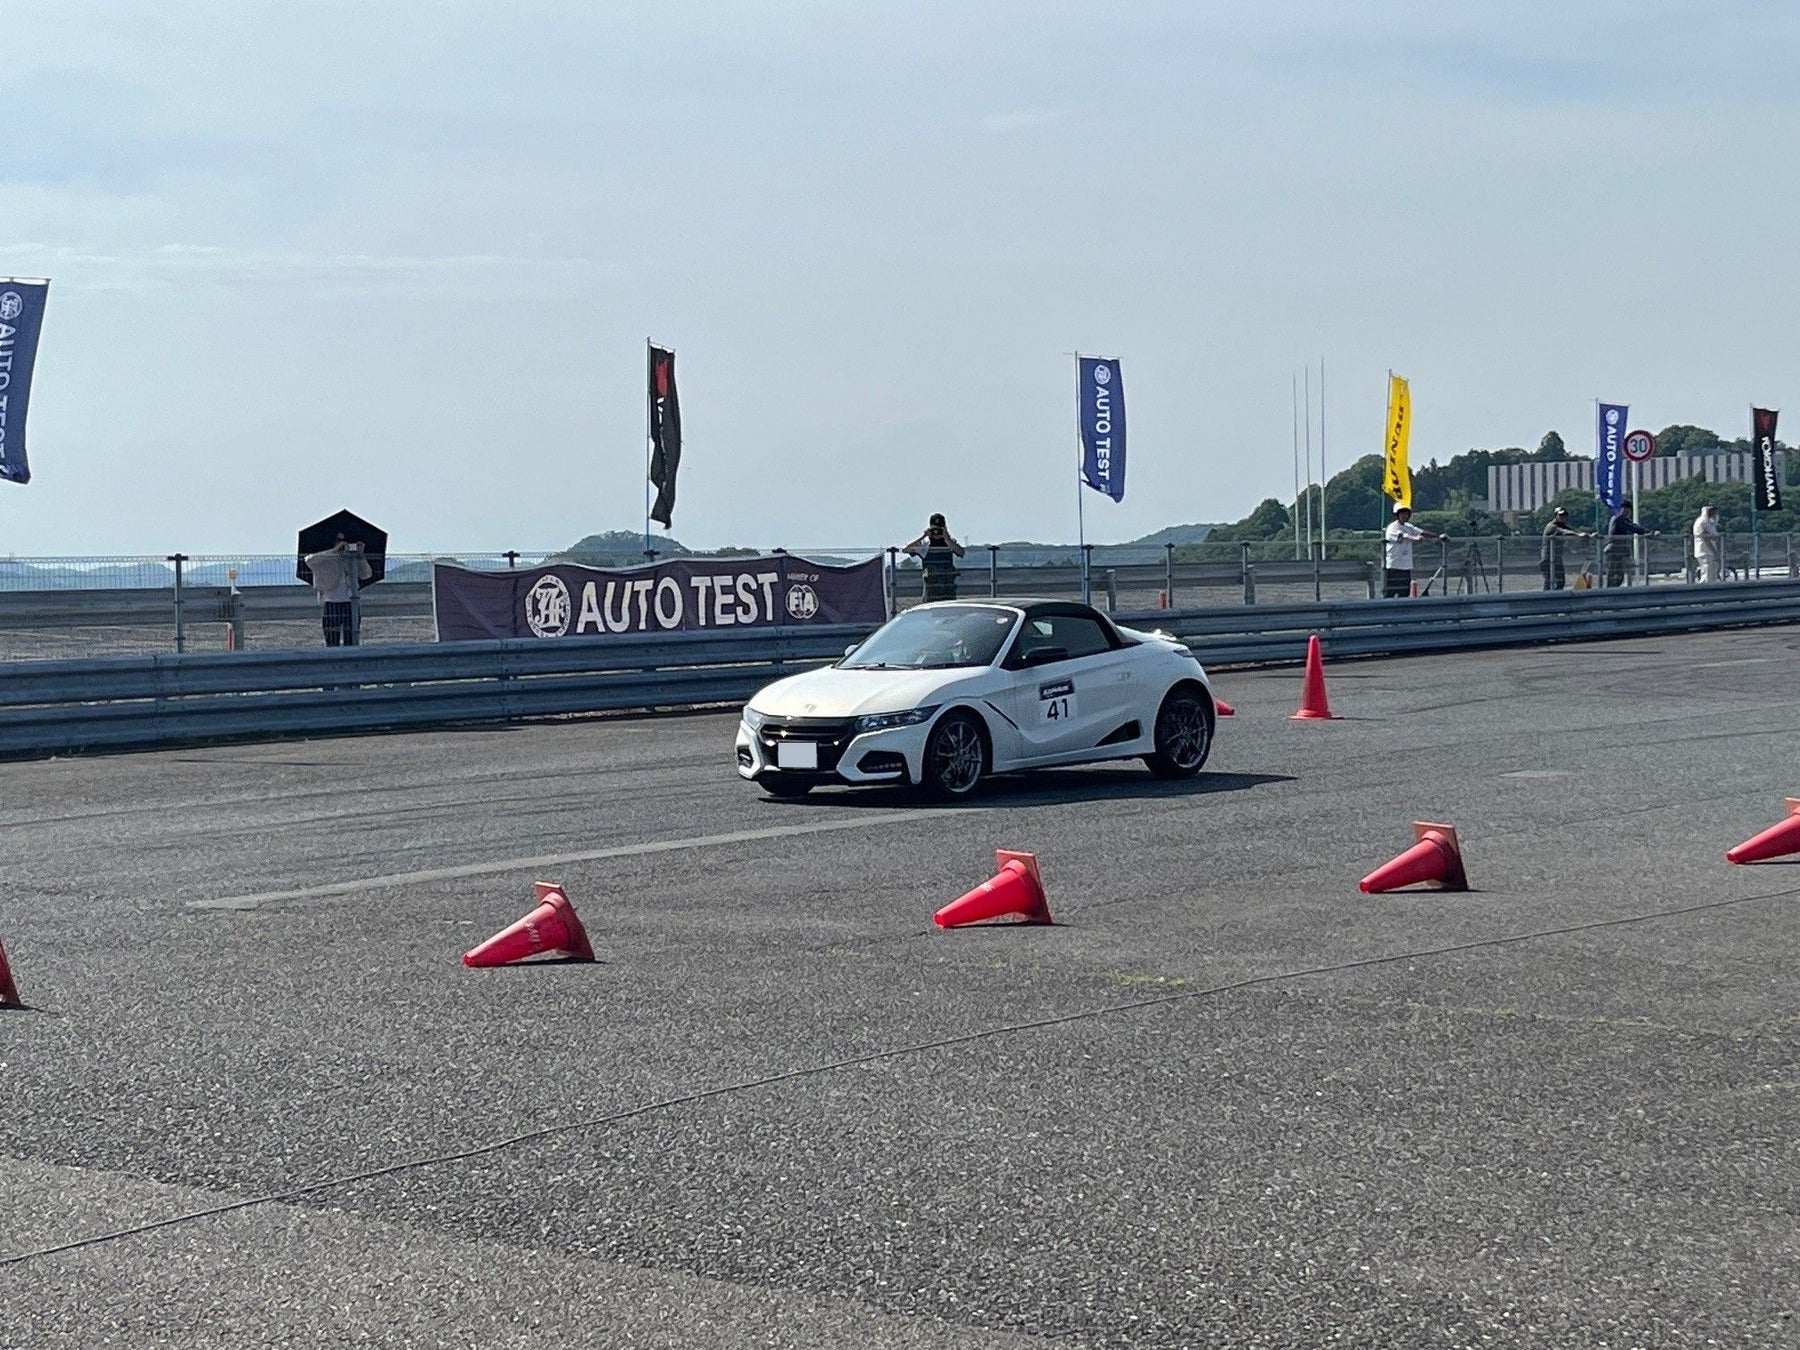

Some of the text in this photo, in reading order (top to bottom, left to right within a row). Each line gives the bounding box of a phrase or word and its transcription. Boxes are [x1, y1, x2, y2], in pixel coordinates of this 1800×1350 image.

[1095, 385, 1112, 434] AUTO
[1095, 437, 1112, 481] TEST
[1606, 425, 1617, 462] AUTO
[1629, 438, 1648, 454] 30
[1761, 435, 1777, 508] YOKOHAMA
[576, 576, 684, 634] AUTO
[690, 571, 779, 626] TEST
[789, 591, 815, 612] FIA
[1047, 698, 1068, 720] 41
